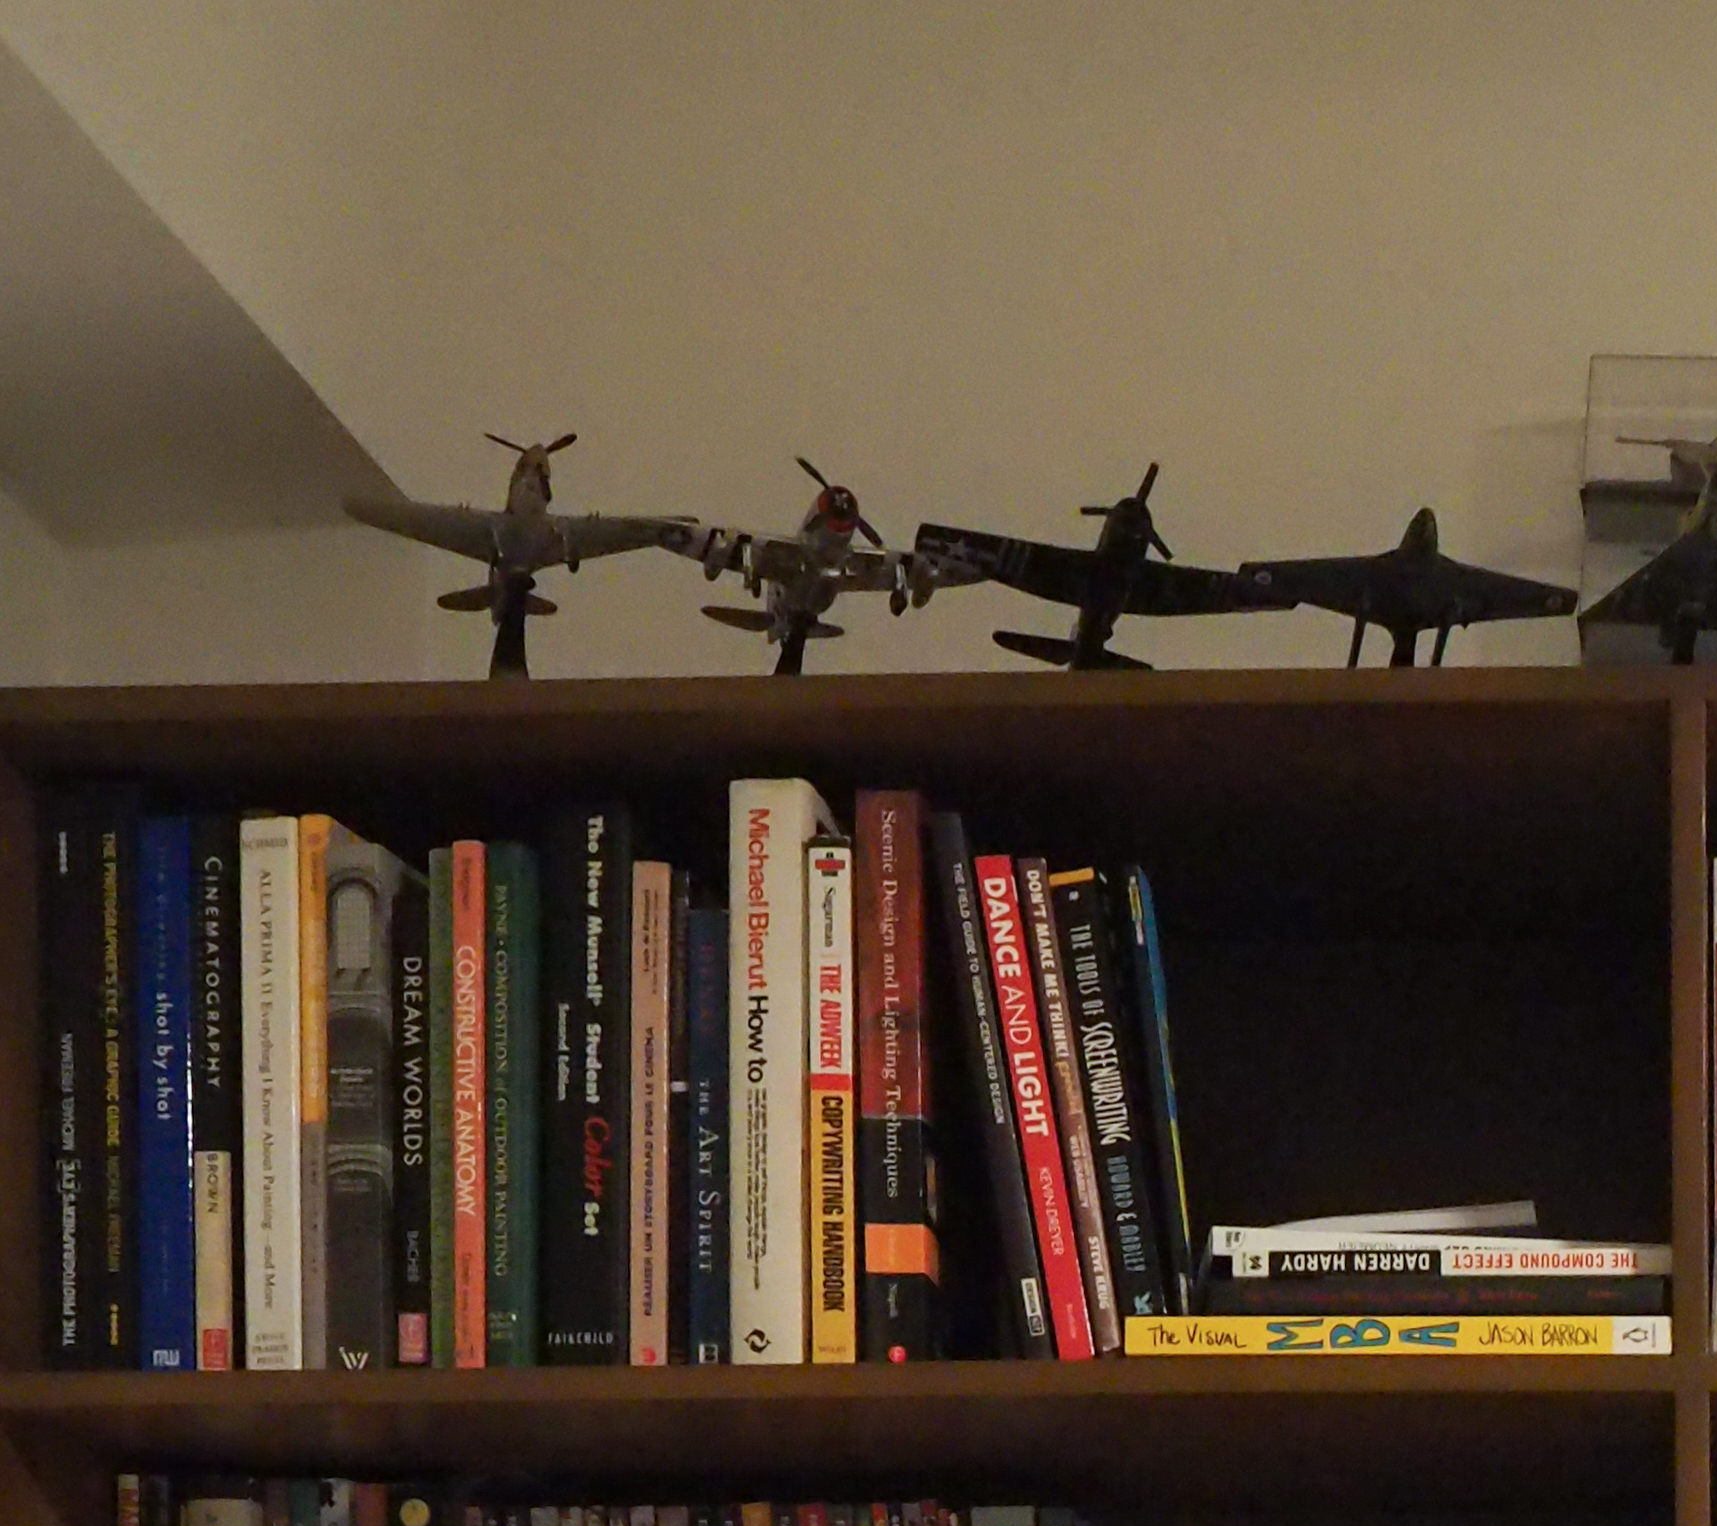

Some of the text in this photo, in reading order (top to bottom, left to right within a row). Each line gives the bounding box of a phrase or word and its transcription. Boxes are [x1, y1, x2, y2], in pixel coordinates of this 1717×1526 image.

[748, 809, 770, 908] Michael
[822, 887, 836, 947] Sugarman
[202, 856, 222, 1088] CINEMATOGRAPHY
[747, 912, 770, 990] Bierut
[155, 992, 172, 1038] shot
[747, 995, 770, 1050] How
[983, 877, 1048, 1137] DANCE AND LIGHT
[1070, 924, 1132, 1145] THE TOOLS OF SCREENWRITING
[152, 1044, 173, 1069] by
[402, 957, 424, 1167] DREAM WORLDS
[455, 945, 477, 1215] CONSTRUCTIVE ANATOMY
[748, 1056, 769, 1083] to
[156, 1077, 172, 1120] shot
[821, 964, 845, 1312] THE ADWEEK COPYWRITING HANDBOOK
[207, 1153, 218, 1213] BROWN
[1281, 1253, 1430, 1271] DARREN HARDY
[1452, 1253, 1640, 1269] THE COMPOUND EFFECT
[1267, 1319, 1460, 1351] MBA
[1479, 1323, 1599, 1347] JASON BARRON
